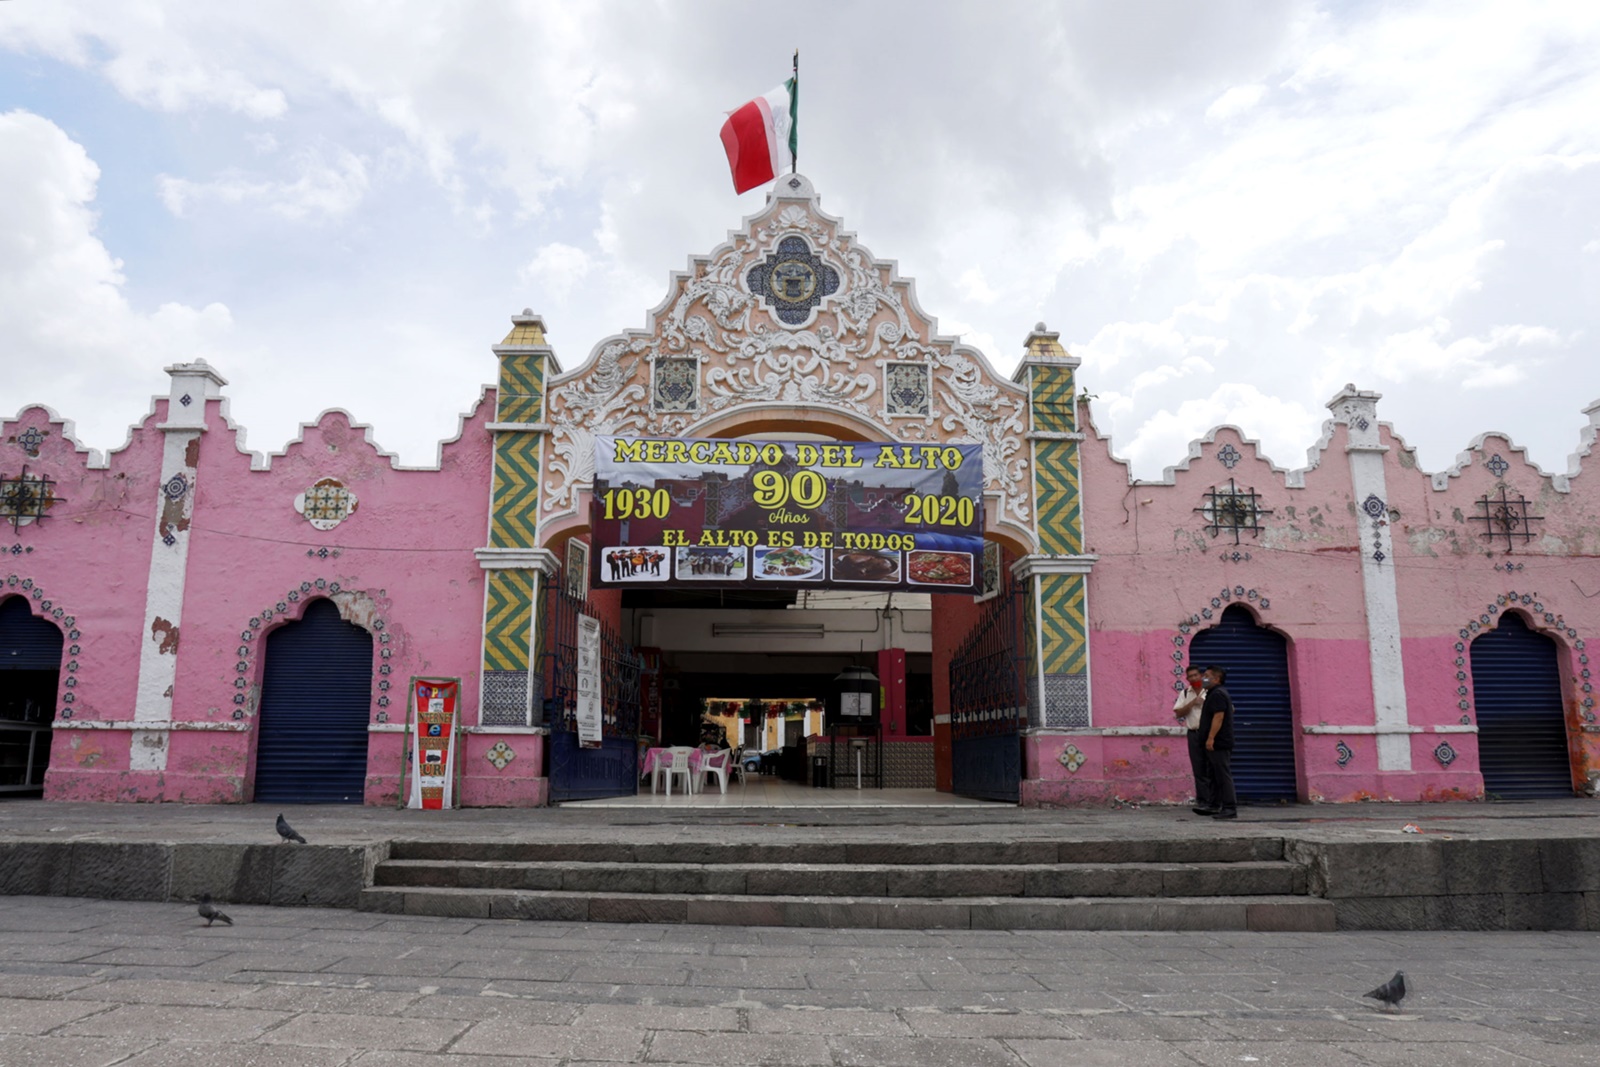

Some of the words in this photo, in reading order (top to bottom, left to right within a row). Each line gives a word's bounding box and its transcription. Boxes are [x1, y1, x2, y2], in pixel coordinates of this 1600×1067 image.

[613, 438, 785, 466] MERCADO
[796, 443, 864, 468] DEL
[873, 445, 965, 471] ALTO
[752, 470, 827, 510] 90
[603, 488, 672, 520] 1930
[768, 508, 811, 524] Años
[904, 494, 975, 527] 2020
[662, 529, 691, 547] EL
[699, 530, 759, 547] ALTO
[767, 531, 796, 548] ES
[802, 531, 834, 549] DE
[841, 532, 916, 551] TODOS
[418, 685, 455, 699] COPIAS
[419, 763, 446, 776] UR
